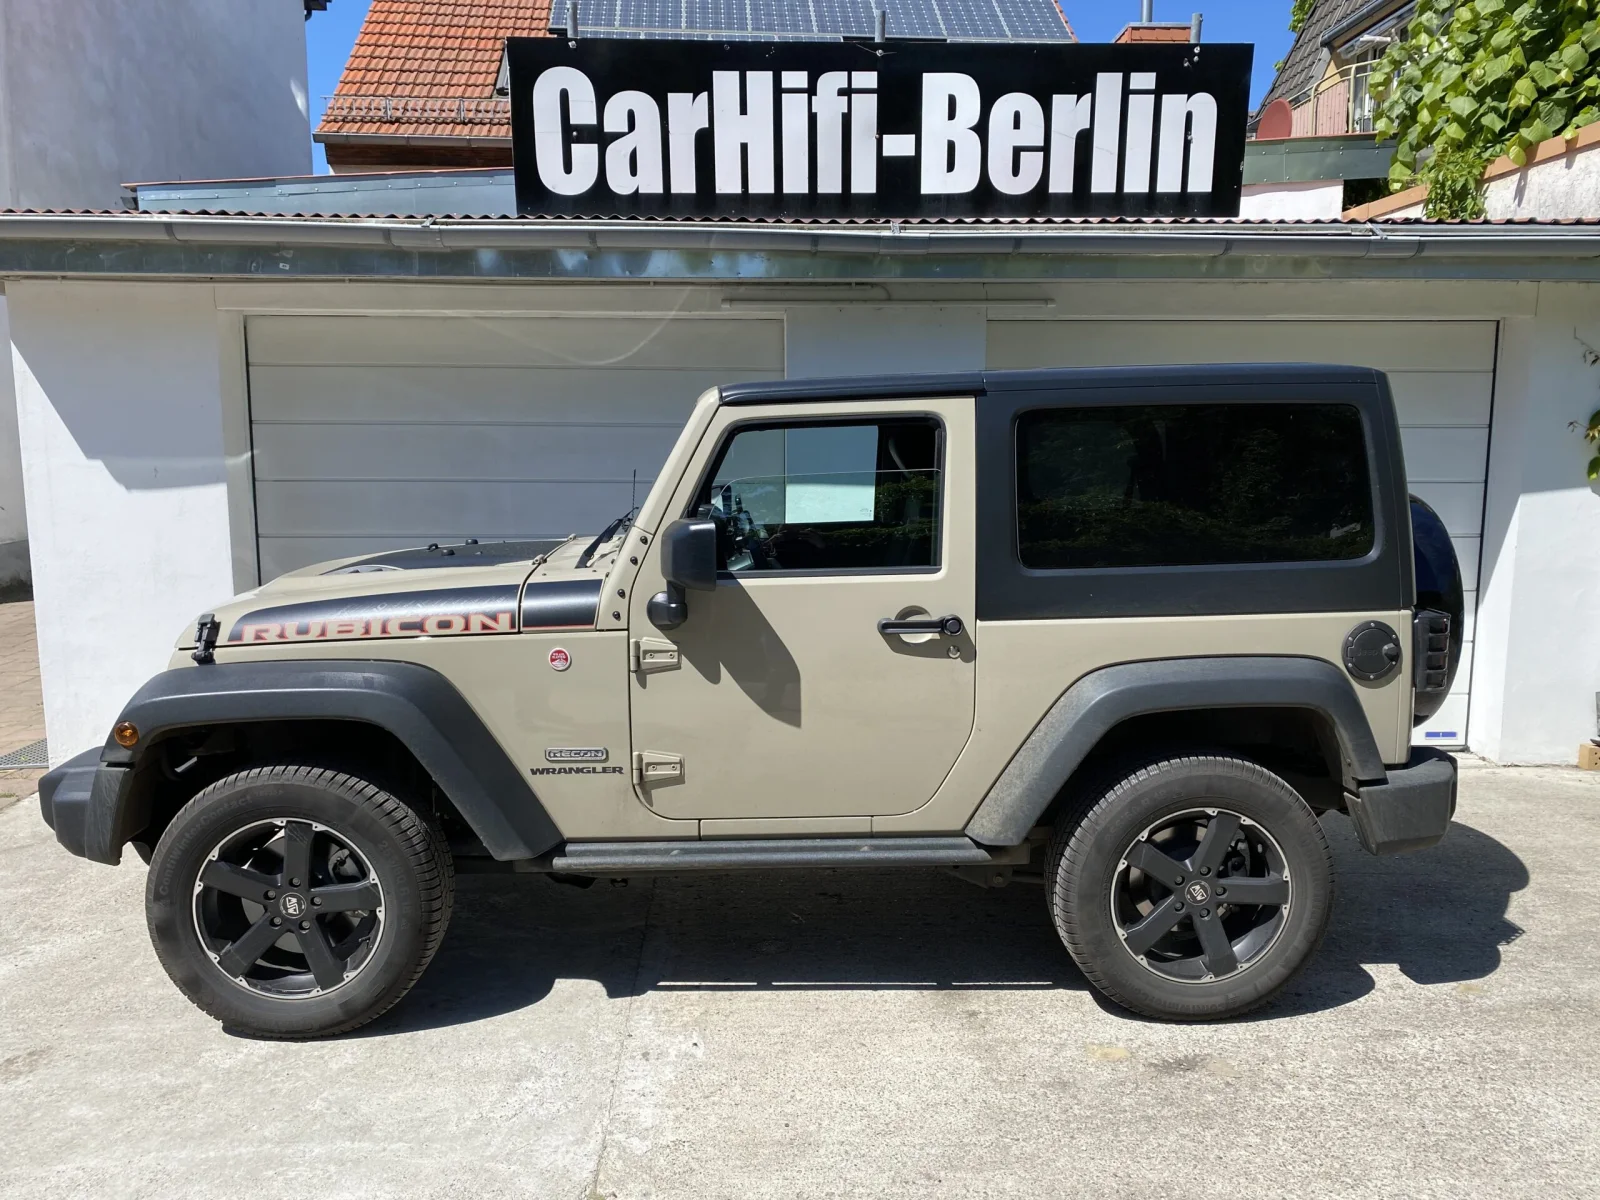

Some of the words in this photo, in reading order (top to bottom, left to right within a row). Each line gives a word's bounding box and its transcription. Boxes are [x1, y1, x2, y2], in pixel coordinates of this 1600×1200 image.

[532, 66, 1217, 195] CarHifi-Berlin
[240, 612, 514, 643] RUBICON
[549, 750, 604, 758] RECON
[530, 766, 624, 775] WRANGLER
